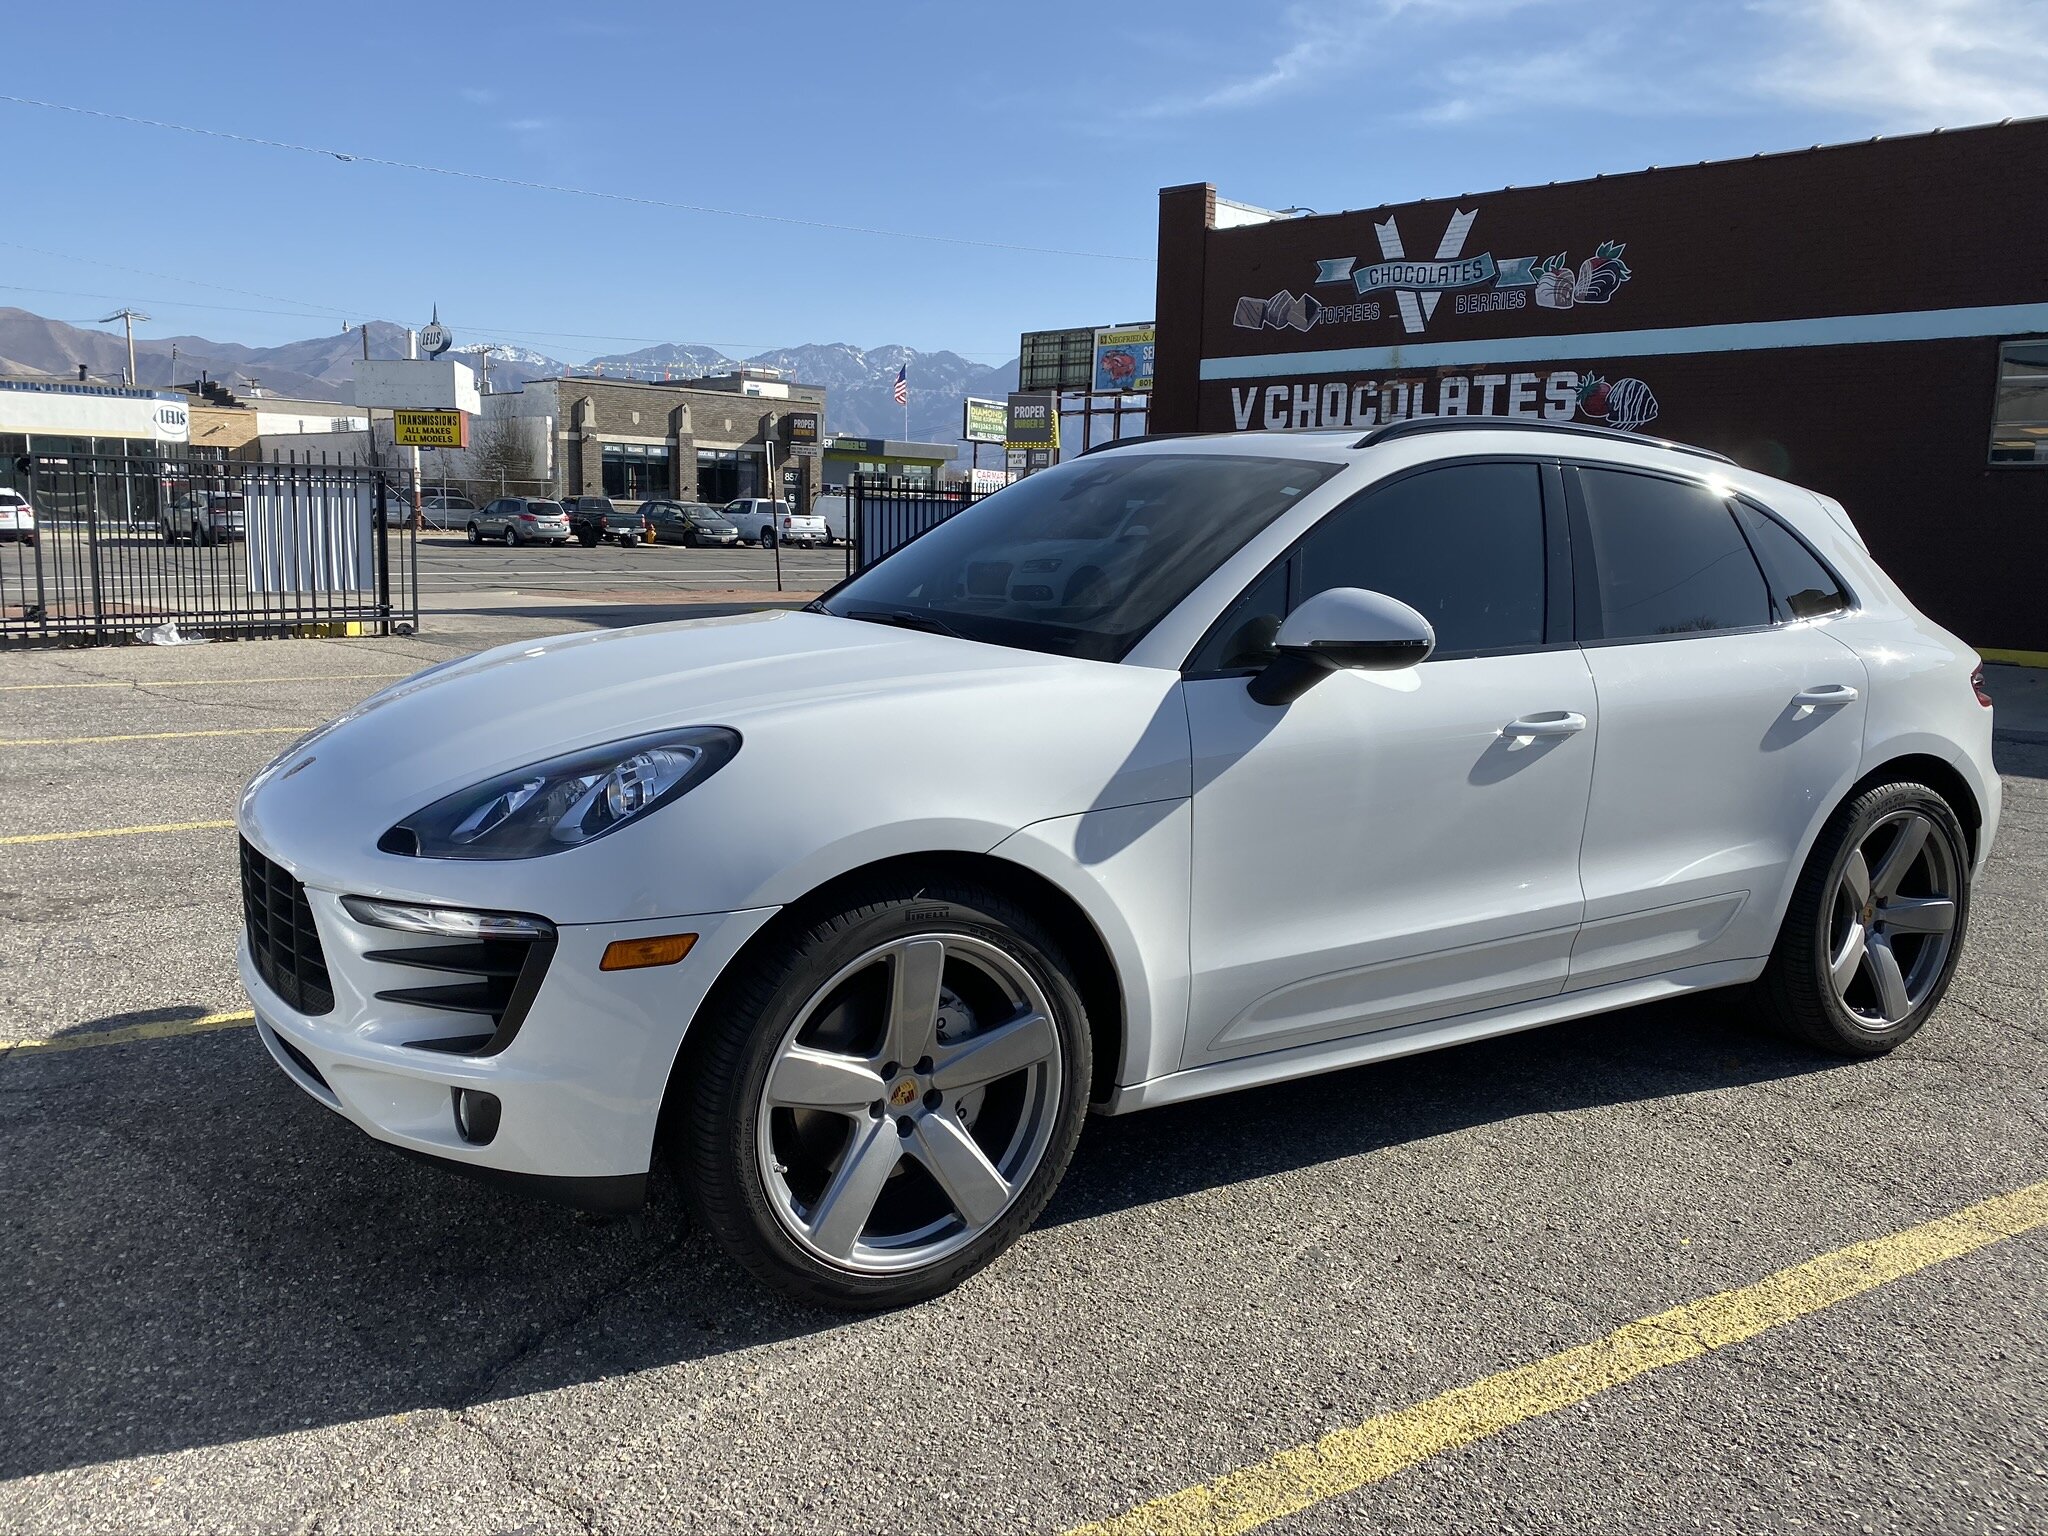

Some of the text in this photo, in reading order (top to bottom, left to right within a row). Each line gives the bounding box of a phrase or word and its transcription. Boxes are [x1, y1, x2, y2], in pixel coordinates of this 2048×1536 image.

[1369, 260, 1484, 286] CHOCOLATES
[1455, 290, 1526, 315] BERRIES
[1317, 302, 1380, 326] TOFFEES
[422, 331, 441, 346] LELIS
[1108, 334, 1141, 345] SIEGFRIED
[1142, 332, 1149, 341] &
[1231, 371, 1579, 430] V CHOCOLATES
[160, 409, 186, 425] LELIS
[970, 406, 1003, 418] DIAMOND
[1014, 405, 1045, 418] PROPER
[398, 414, 457, 427] TRANSMISSIONS
[793, 419, 815, 429] PROPER
[1014, 419, 1038, 429] BURGER
[405, 426, 451, 435] ALL MAKES
[403, 435, 418, 443] ALL
[784, 472, 798, 481] 857
[905, 906, 950, 921] PIRELLI
